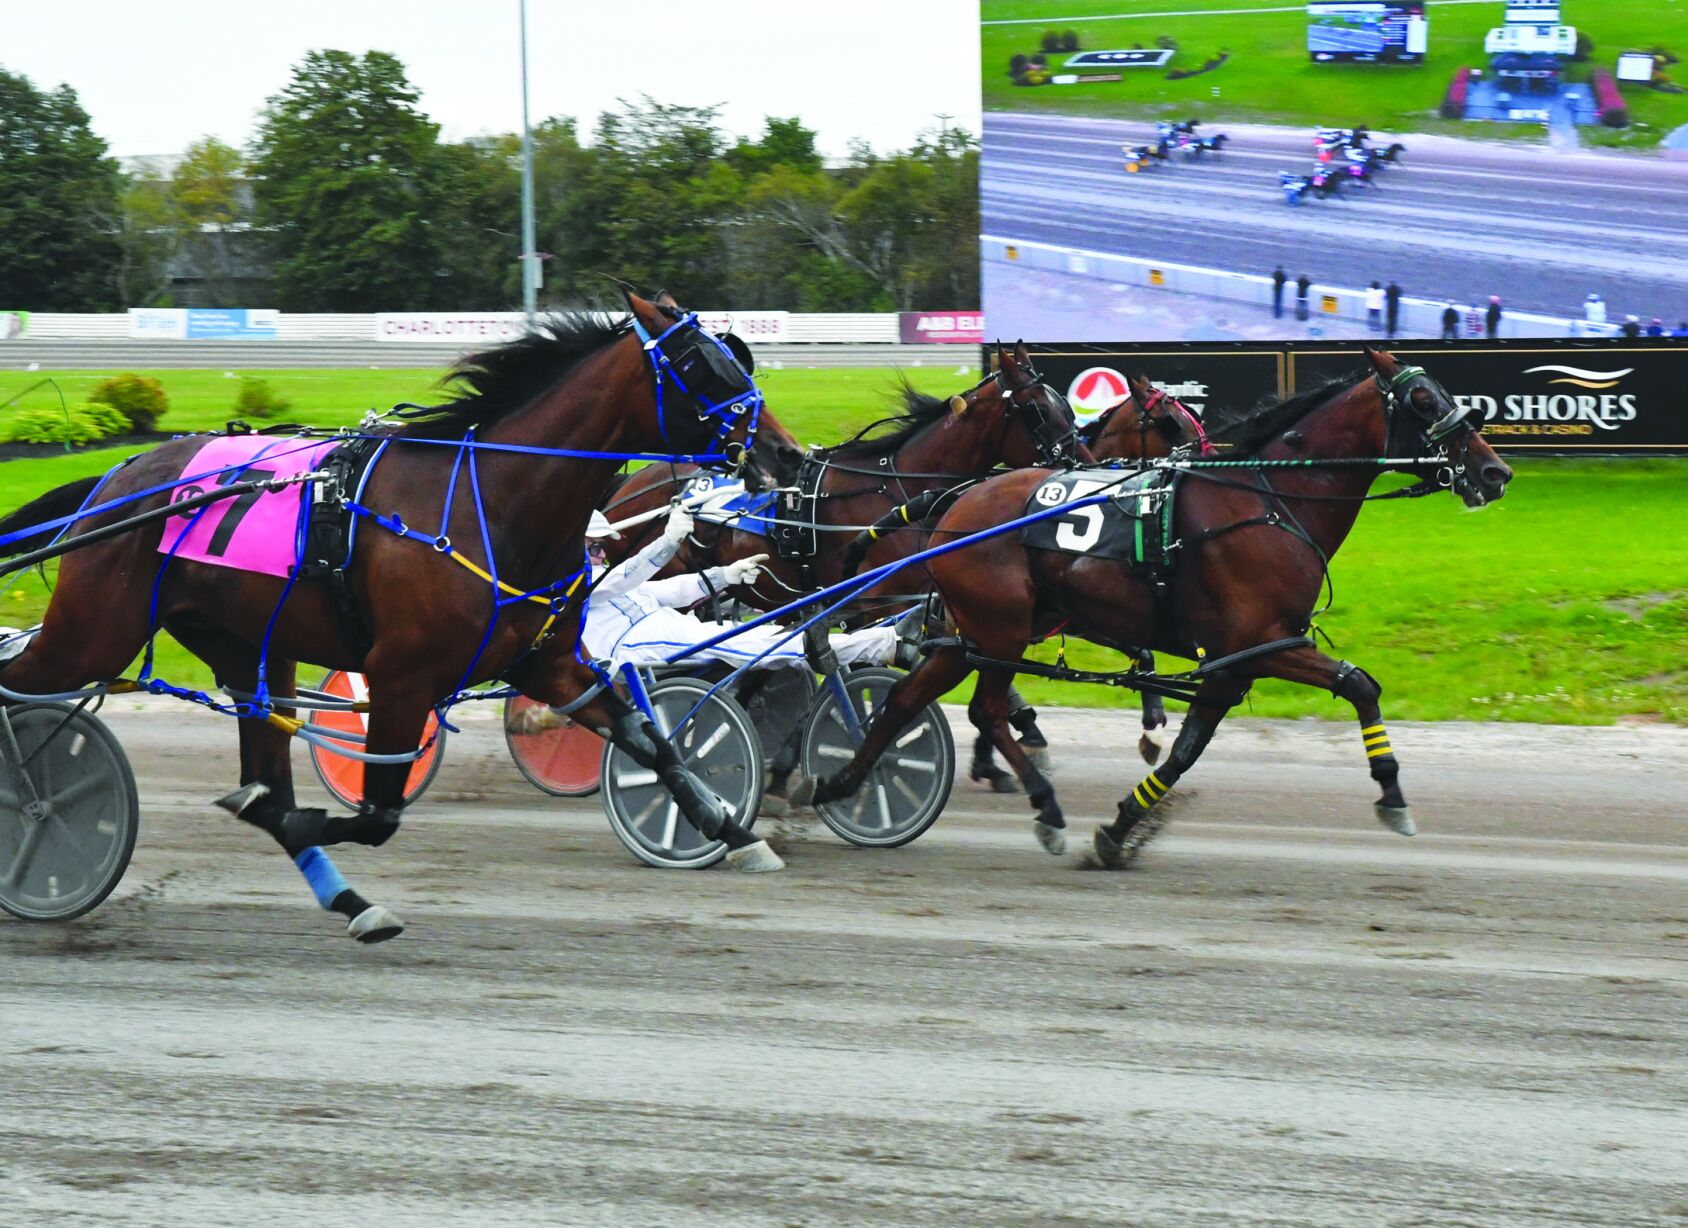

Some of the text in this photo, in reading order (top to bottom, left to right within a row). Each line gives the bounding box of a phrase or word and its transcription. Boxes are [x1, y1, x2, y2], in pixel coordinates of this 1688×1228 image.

[382, 320, 516, 335] CHARLOTTETO
[1452, 394, 1637, 430] ED SHORES
[1542, 424, 1593, 435] CASINO
[1040, 486, 1063, 502] 13
[206, 463, 276, 557] 7
[1055, 479, 1123, 552] 5
